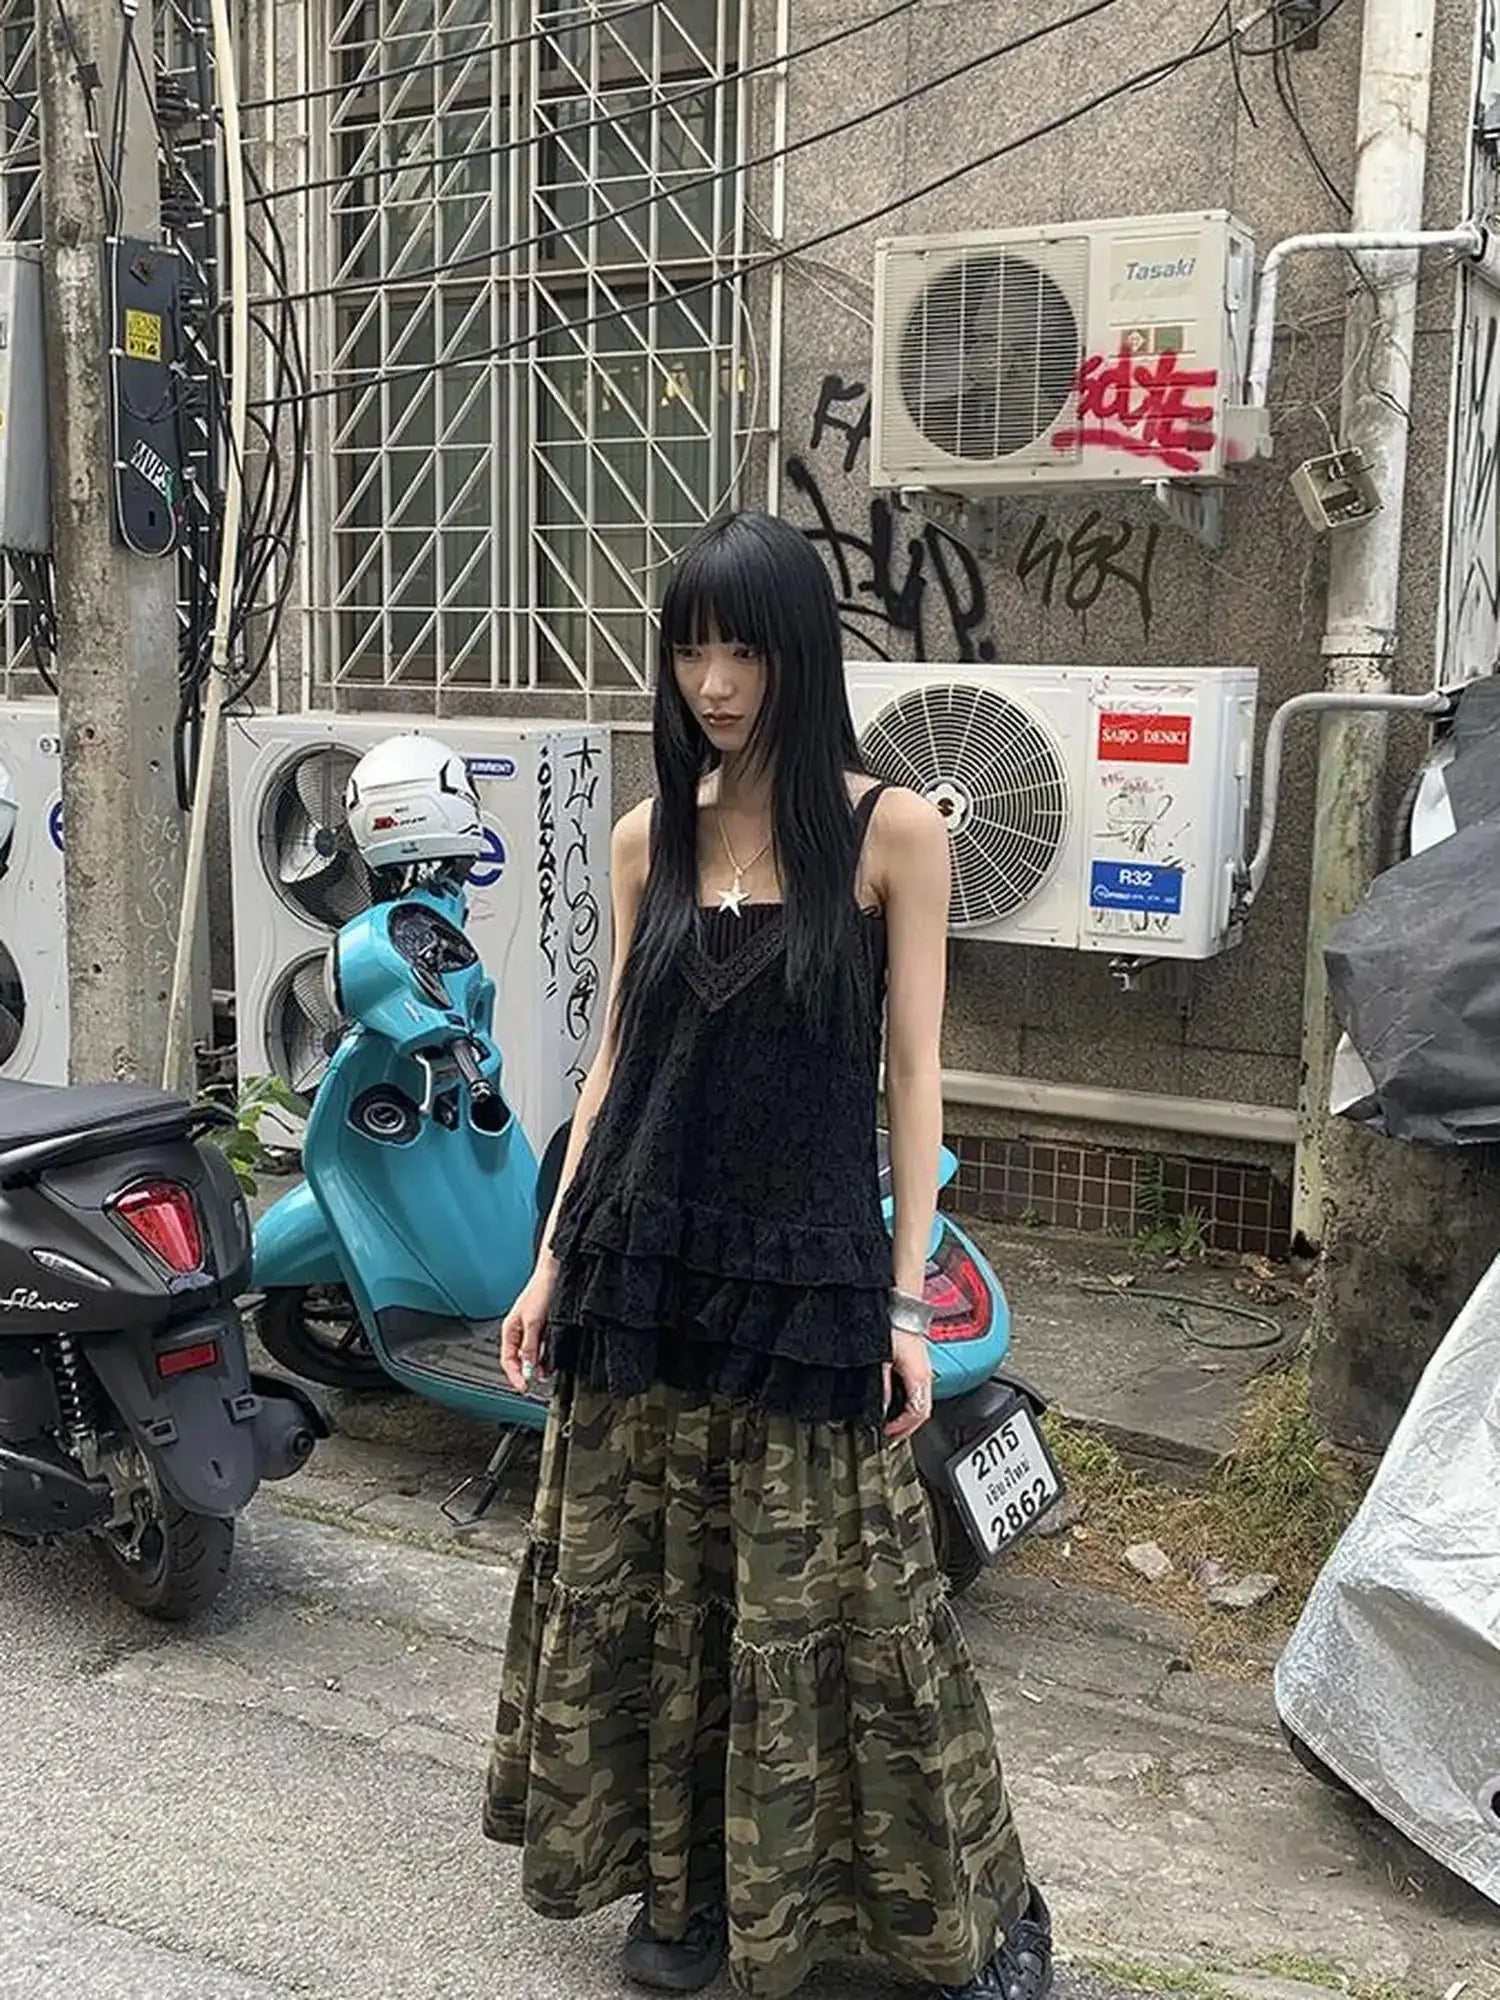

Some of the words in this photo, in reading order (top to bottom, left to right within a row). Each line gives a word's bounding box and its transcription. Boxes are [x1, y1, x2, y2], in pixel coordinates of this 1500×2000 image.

[1126, 257, 1197, 280] Tasaki
[1119, 869, 1153, 887] R32
[971, 1421, 1020, 1481] 2กธ
[991, 1477, 1052, 1547] 2862
